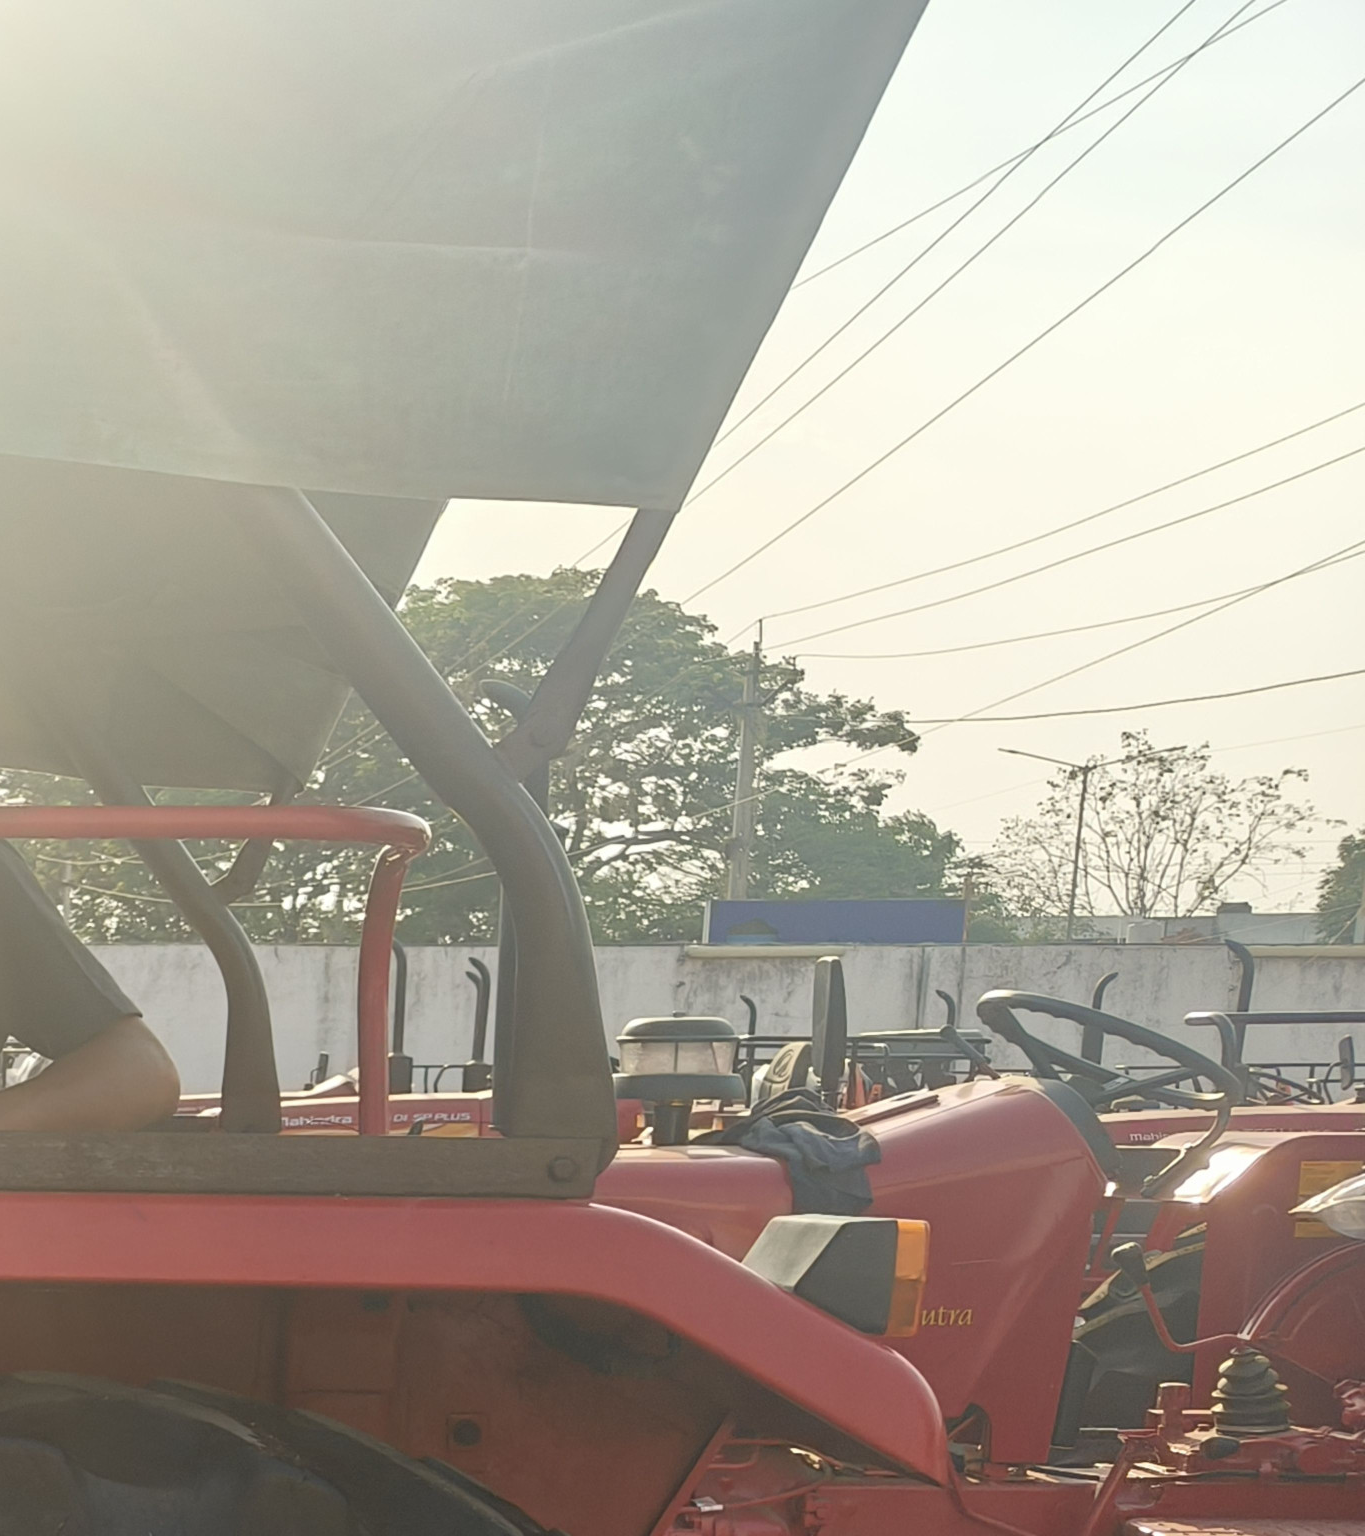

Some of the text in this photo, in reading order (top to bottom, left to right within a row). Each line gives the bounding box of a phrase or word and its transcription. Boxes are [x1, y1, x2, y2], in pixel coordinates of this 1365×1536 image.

[393, 1114, 408, 1123] DI
[434, 1112, 471, 1122] PLUS
[921, 1306, 973, 1326] utra
